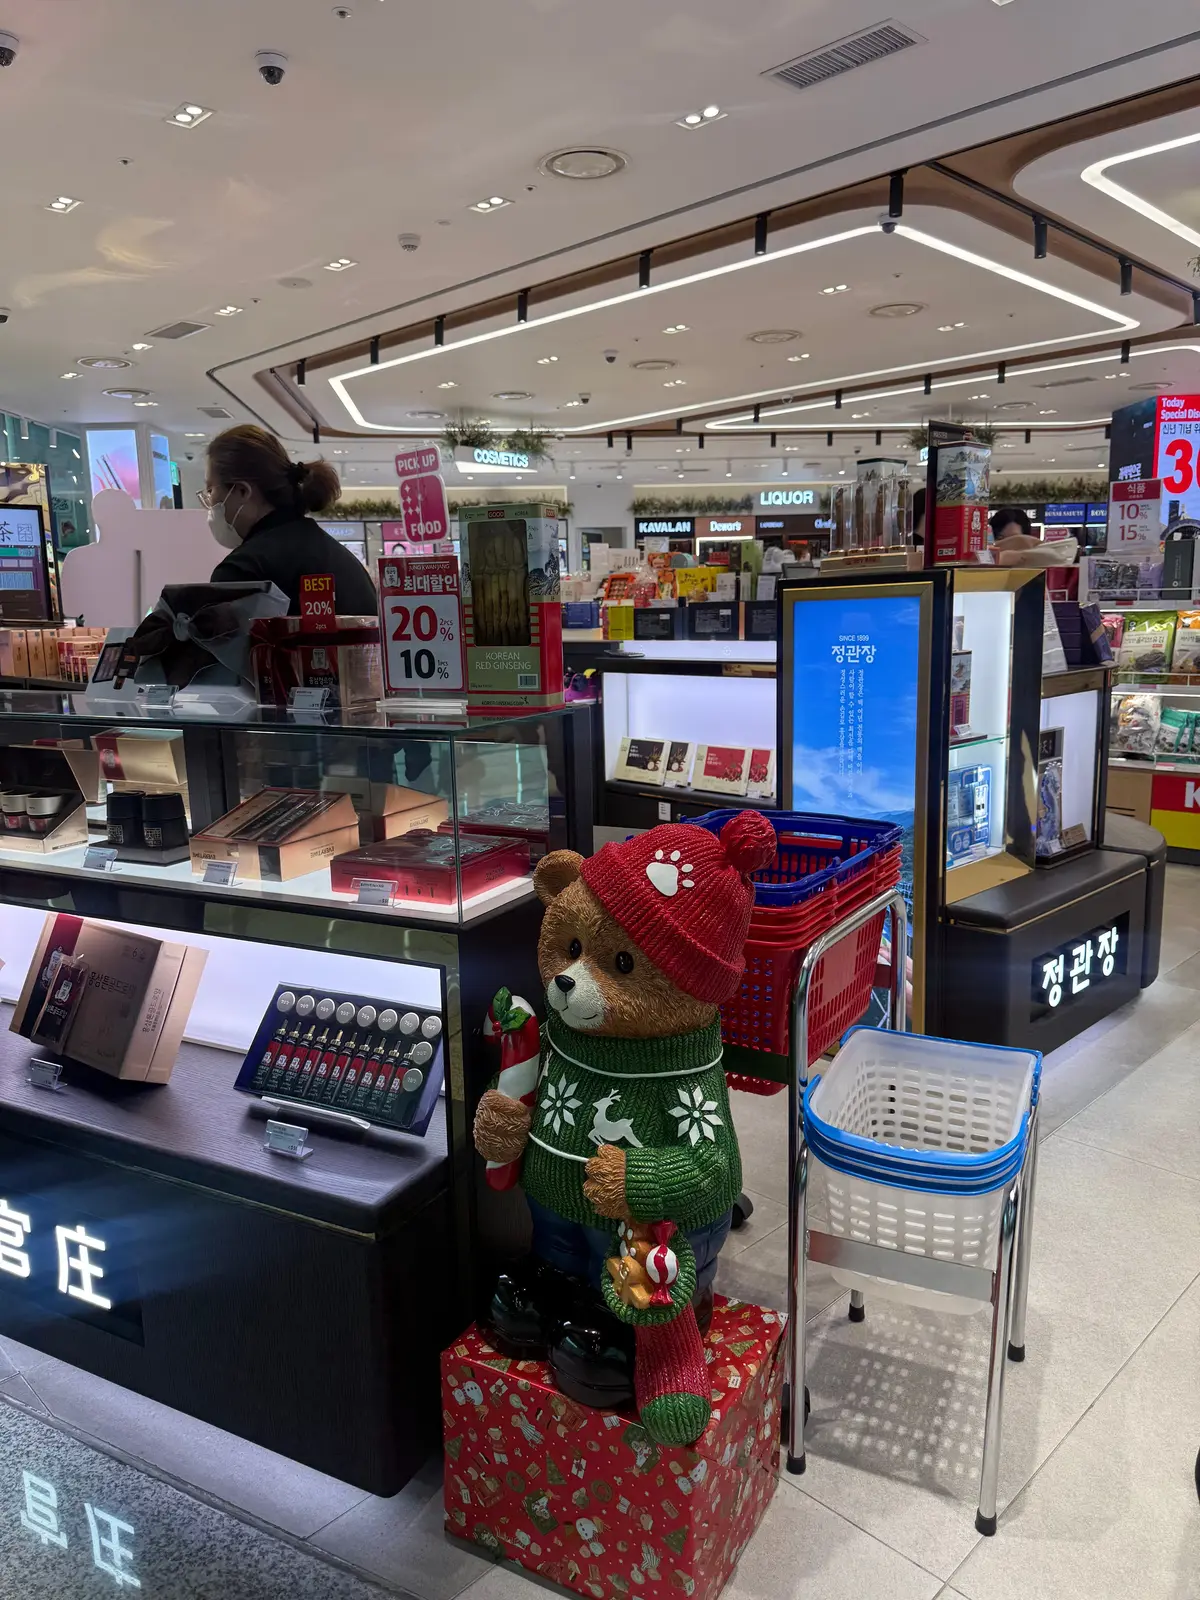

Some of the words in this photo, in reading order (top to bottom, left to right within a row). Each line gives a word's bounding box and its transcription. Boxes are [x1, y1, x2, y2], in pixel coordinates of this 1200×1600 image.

[1162, 398, 1185, 408] Today
[1161, 409, 1187, 421] Special
[1188, 408, 1200, 419] Dis
[397, 457, 419, 471] PICK
[422, 454, 436, 467] UP
[474, 448, 529, 468] COSMETICS
[1163, 438, 1200, 494] 3
[760, 490, 814, 505] LIQUOR
[410, 520, 442, 537] FOOD
[639, 521, 691, 533] KAVALAN
[303, 577, 332, 592] BEST
[403, 573, 458, 593] 최대할인
[305, 600, 332, 615] 20%
[838, 634, 856, 642] SINCE
[485, 652, 520, 660] KOREAN
[831, 645, 877, 663] 정관장
[475, 661, 491, 670] RED
[493, 661, 531, 670] GINSENG
[1041, 926, 1119, 1008] 정관장
